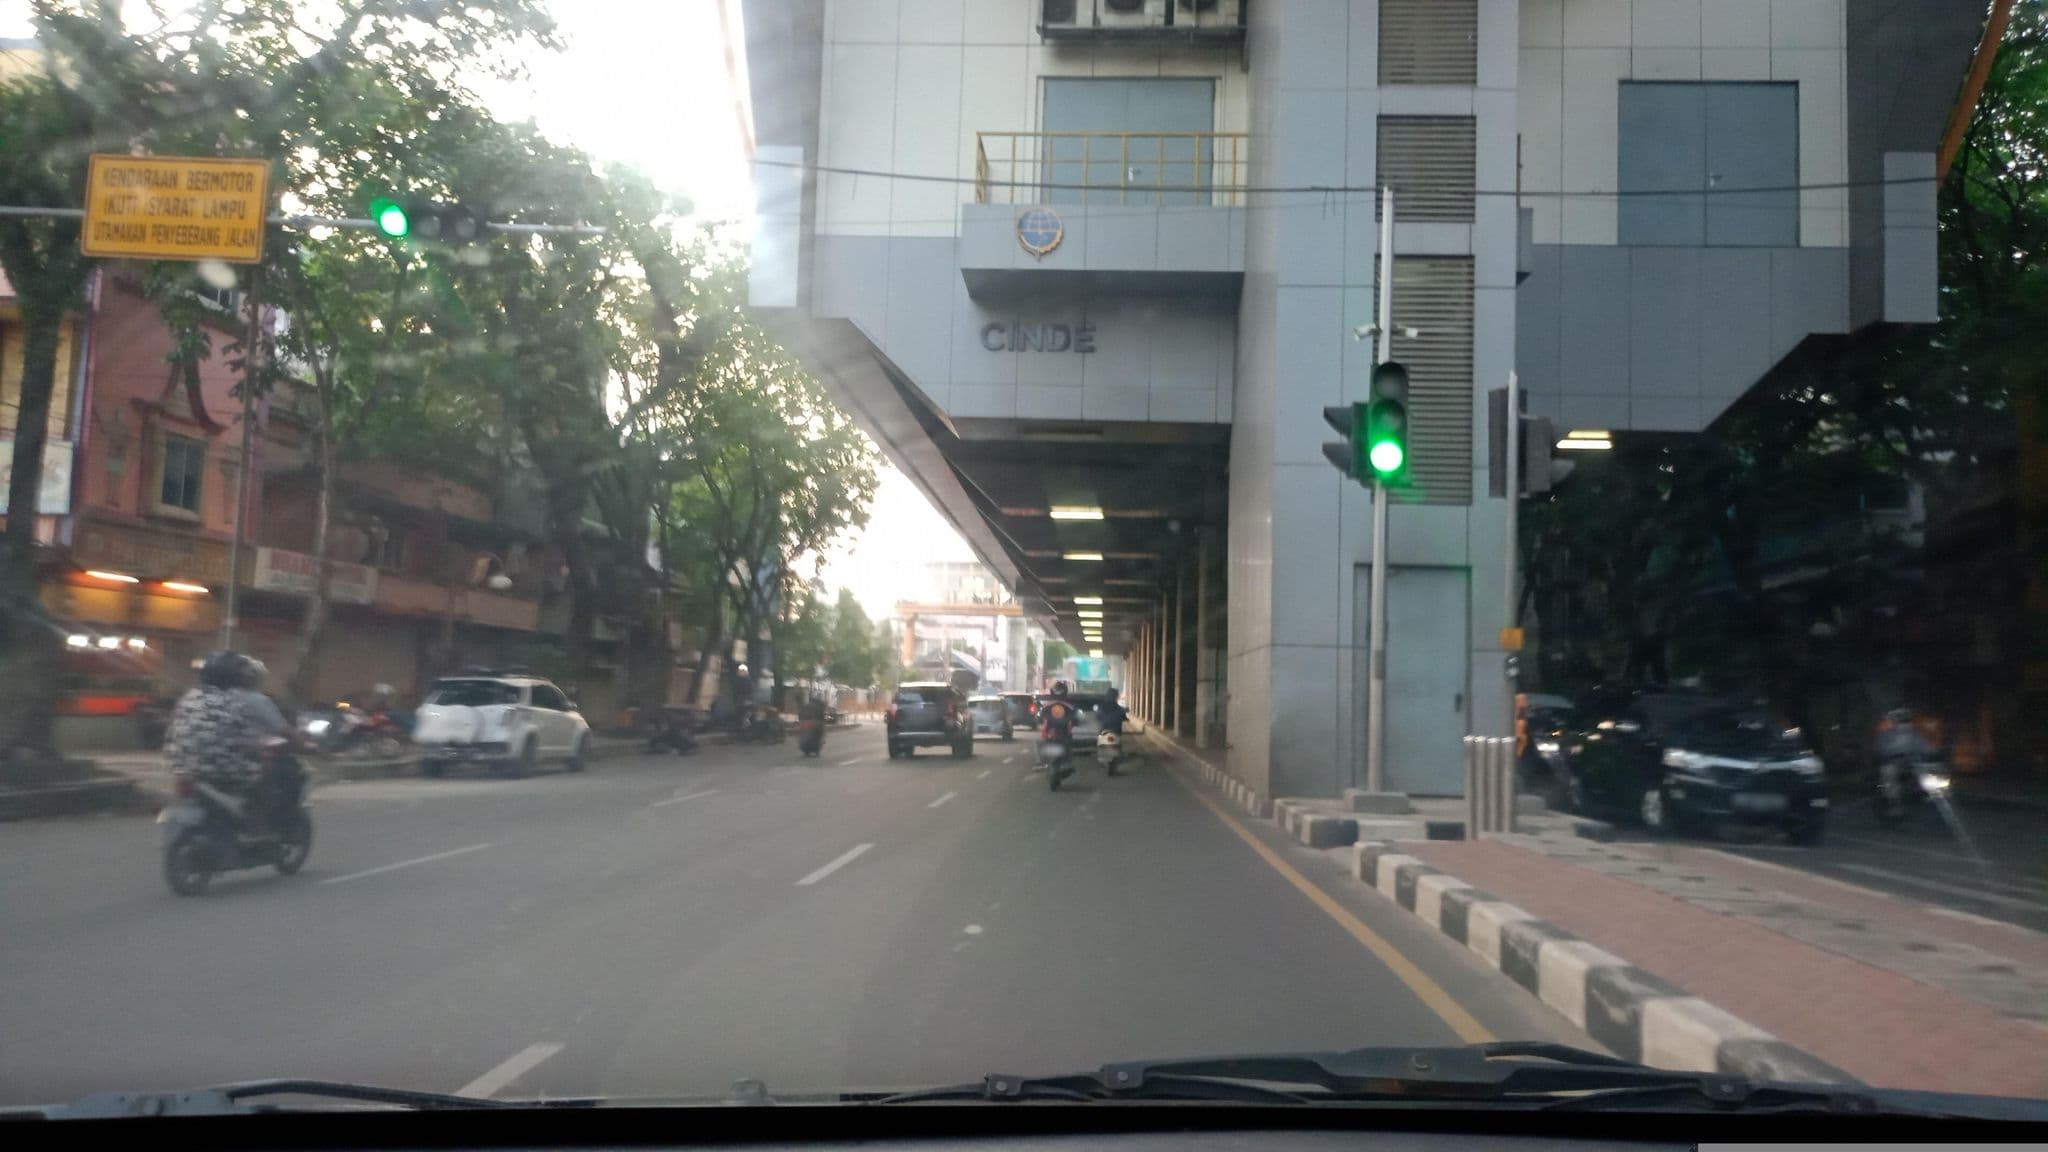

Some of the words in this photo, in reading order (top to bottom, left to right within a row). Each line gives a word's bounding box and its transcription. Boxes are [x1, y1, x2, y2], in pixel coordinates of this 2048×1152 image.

[187, 171, 255, 192] BERMOTOR
[203, 199, 246, 219] LAMPU
[94, 222, 146, 242] UTAMAKAN
[152, 224, 220, 246] PENYEBERANG
[225, 227, 256, 248] JALAN
[981, 323, 1097, 353] CINDE
